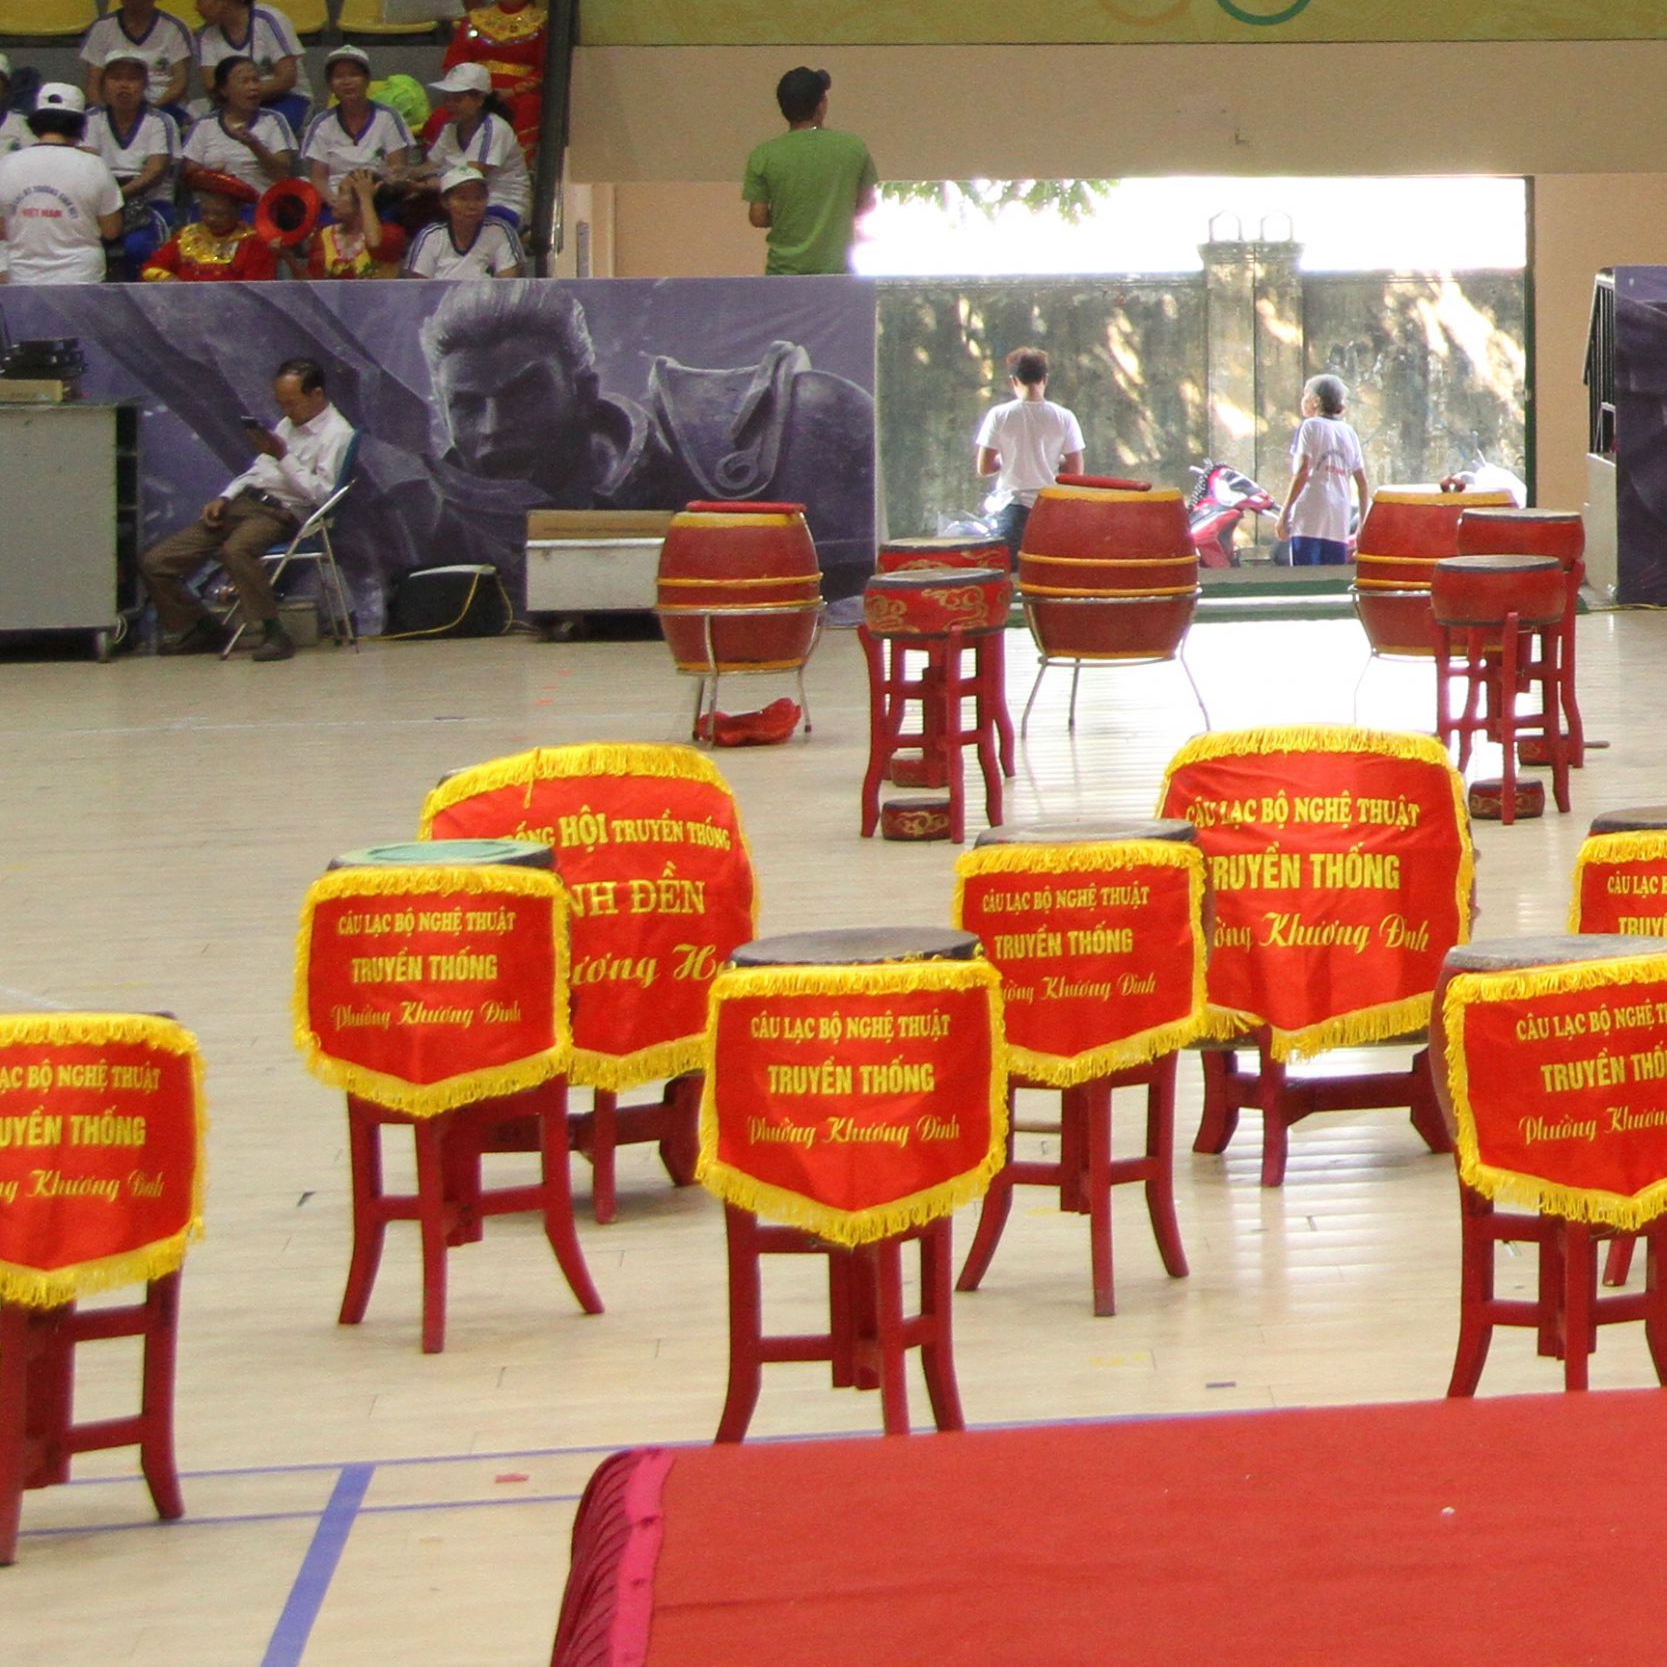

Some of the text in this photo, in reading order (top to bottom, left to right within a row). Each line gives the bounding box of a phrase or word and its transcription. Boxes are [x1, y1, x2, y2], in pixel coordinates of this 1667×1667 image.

[559, 805, 608, 852] HỘI
[611, 809, 684, 843] TRUYỀN
[687, 816, 730, 851] THỐNG
[629, 861, 705, 914] ĐỀN
[365, 914, 391, 937] LẠC
[395, 907, 415, 937] BỘ
[419, 906, 462, 936] NGHỆ
[466, 906, 516, 936] THUẬT
[352, 946, 497, 983] TRUYỀN THỐNG
[398, 1001, 474, 1028] Khương
[1516, 1013, 1549, 1040] CÂU
[1553, 1014, 1586, 1040] LẠC
[1589, 1004, 1611, 1036] BỘ
[1614, 999, 1654, 1030] NGHỆ
[1541, 1048, 1626, 1092] TRUYỀN
[1519, 1114, 1597, 1145] Phường
